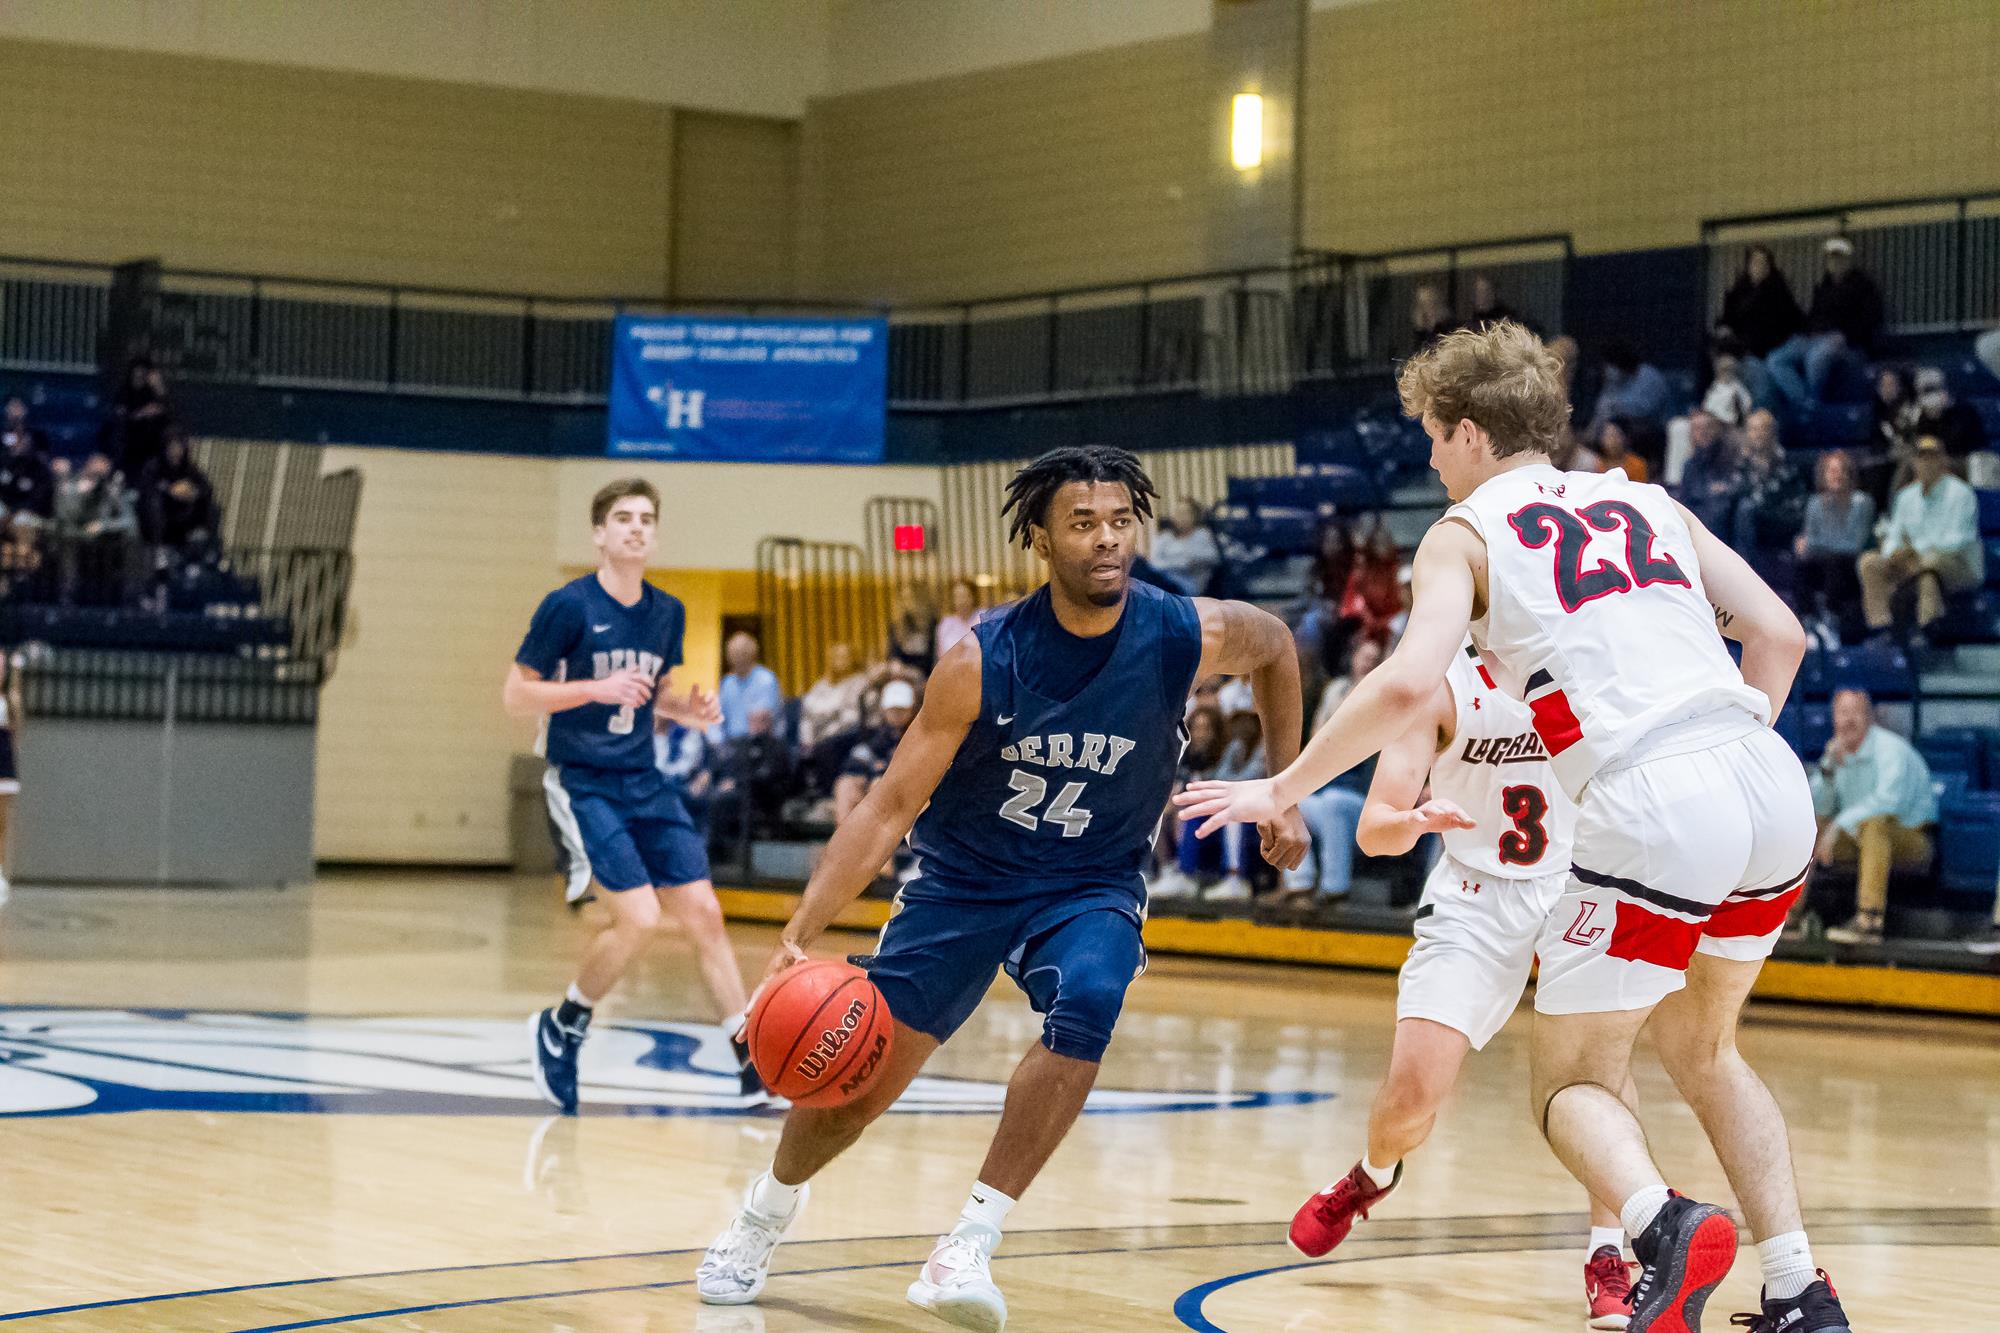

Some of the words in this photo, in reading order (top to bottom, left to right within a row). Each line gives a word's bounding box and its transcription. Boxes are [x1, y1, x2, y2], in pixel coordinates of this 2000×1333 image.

[1507, 500, 1692, 614] 22
[999, 769, 1093, 837] 24
[1499, 785, 1549, 866] 3
[795, 998, 868, 1081] Wilson
[839, 1033, 887, 1096] NCAA
